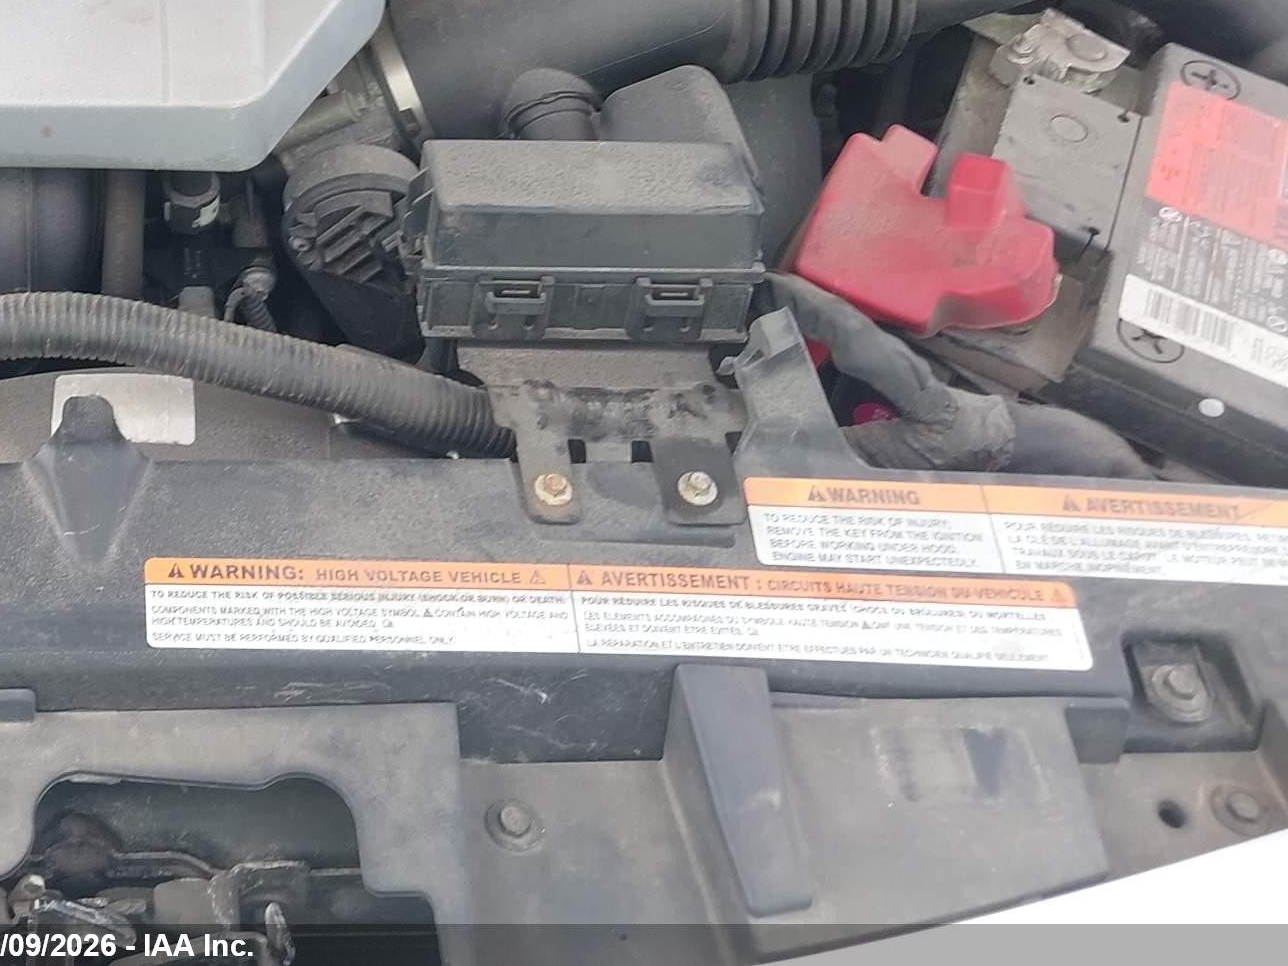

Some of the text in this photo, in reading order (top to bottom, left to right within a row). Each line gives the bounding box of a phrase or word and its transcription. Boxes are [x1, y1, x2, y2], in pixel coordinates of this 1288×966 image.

[827, 486, 921, 506] WARNING
[1087, 497, 1240, 520] AVERTISSEMENT
[764, 513, 780, 523] TO
[783, 513, 828, 525] REDUCE
[835, 515, 855, 526] THE
[859, 516, 883, 526] RISK
[887, 516, 902, 527] OF
[768, 525, 815, 537] REMOVE
[820, 527, 840, 538] THE
[844, 528, 867, 539] KEY
[871, 529, 902, 540] FROM
[908, 530, 929, 541] THE
[770, 538, 816, 550] BEFORE
[820, 540, 874, 552] WORKING
[878, 542, 918, 553] UNDER
[773, 551, 815, 563] ENGINE
[819, 552, 842, 564] MAY
[846, 554, 881, 565] START
[190, 562, 522, 585] WARNING: HIGH VOLTAGE VEHICLE
[602, 571, 750, 590] AVERTISSEMENT
[767, 581, 831, 594] CIRCUITS
[836, 583, 882, 596] HAUTE
[887, 585, 947, 598] TENSION
[150, 590, 164, 600] TO
[168, 591, 208, 600] REDUCE
[212, 591, 231, 600] THE
[234, 592, 258, 601] RISK
[262, 592, 274, 601] OF
[290, 607, 307, 617] THE
